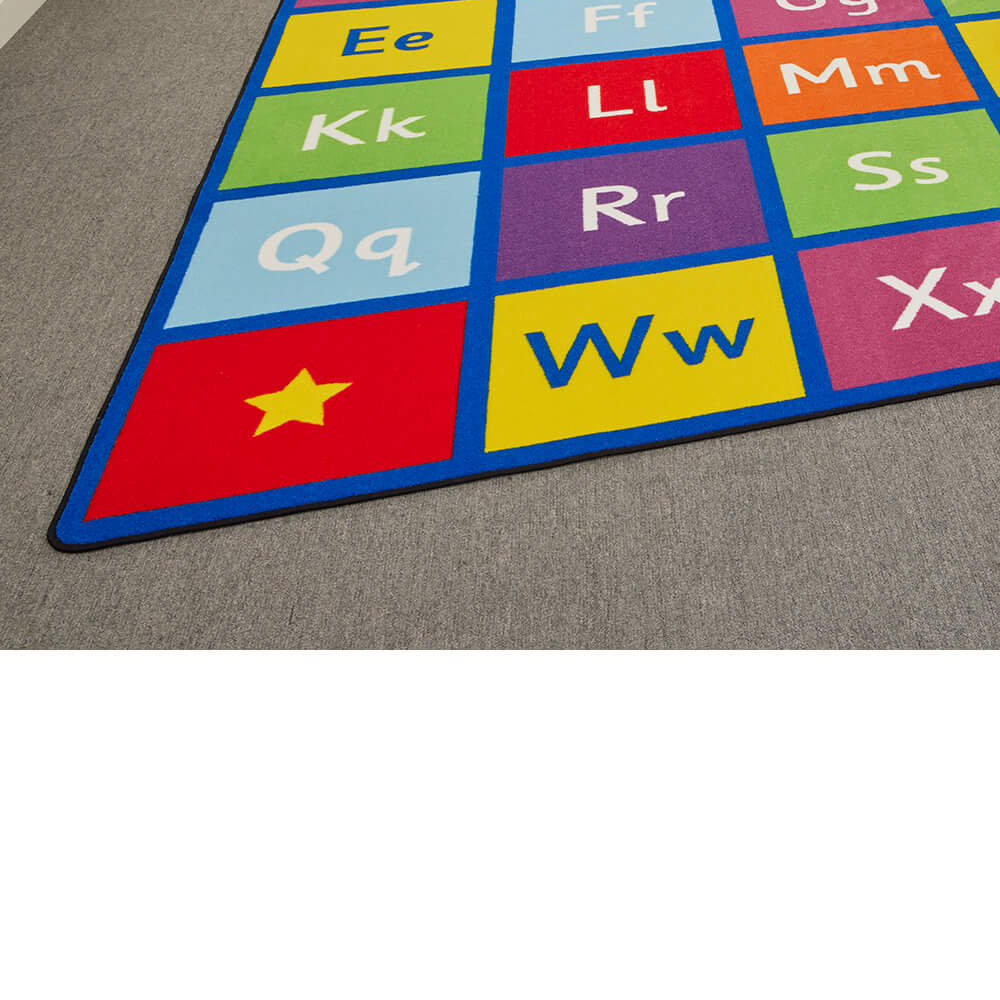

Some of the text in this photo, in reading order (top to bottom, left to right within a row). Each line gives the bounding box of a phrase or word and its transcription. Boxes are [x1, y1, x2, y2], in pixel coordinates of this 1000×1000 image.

[583, 0, 658, 34] Ff
[342, 25, 434, 57] Ee
[780, 57, 941, 95] Mm
[588, 79, 667, 119] Ll
[302, 107, 425, 152] Kk
[847, 151, 949, 191] Ss
[581, 184, 686, 232] Rr
[257, 220, 422, 278] Qq
[525, 314, 754, 388] Ww
